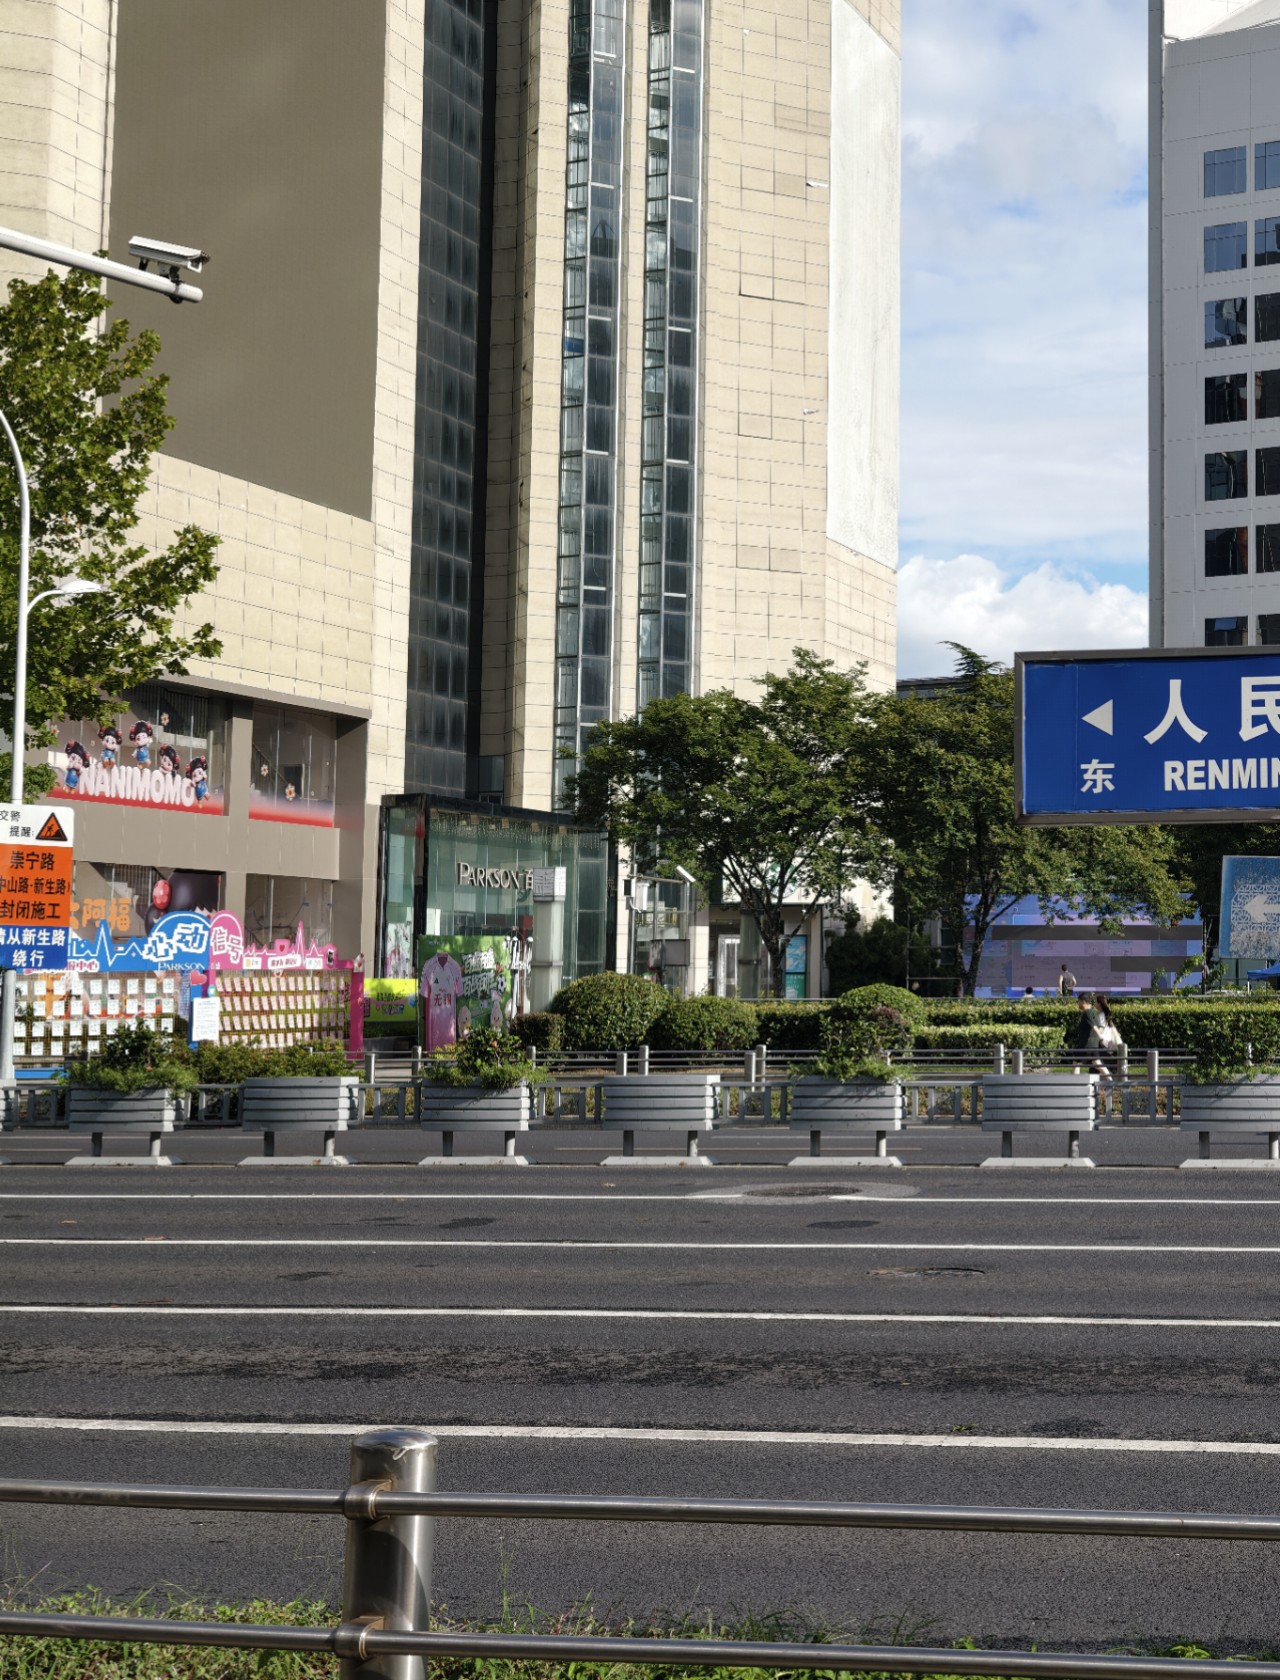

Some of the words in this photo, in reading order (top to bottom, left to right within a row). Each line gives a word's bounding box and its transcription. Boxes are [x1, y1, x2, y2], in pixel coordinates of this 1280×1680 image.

[79, 763, 196, 807] NANIMOMO
[1080, 758, 1116, 794] 东
[10, 851, 55, 871] 崇宁路
[457, 862, 519, 889] PARKSON
[0, 900, 61, 920] 封闭施工
[12, 950, 45, 967] 绕行
